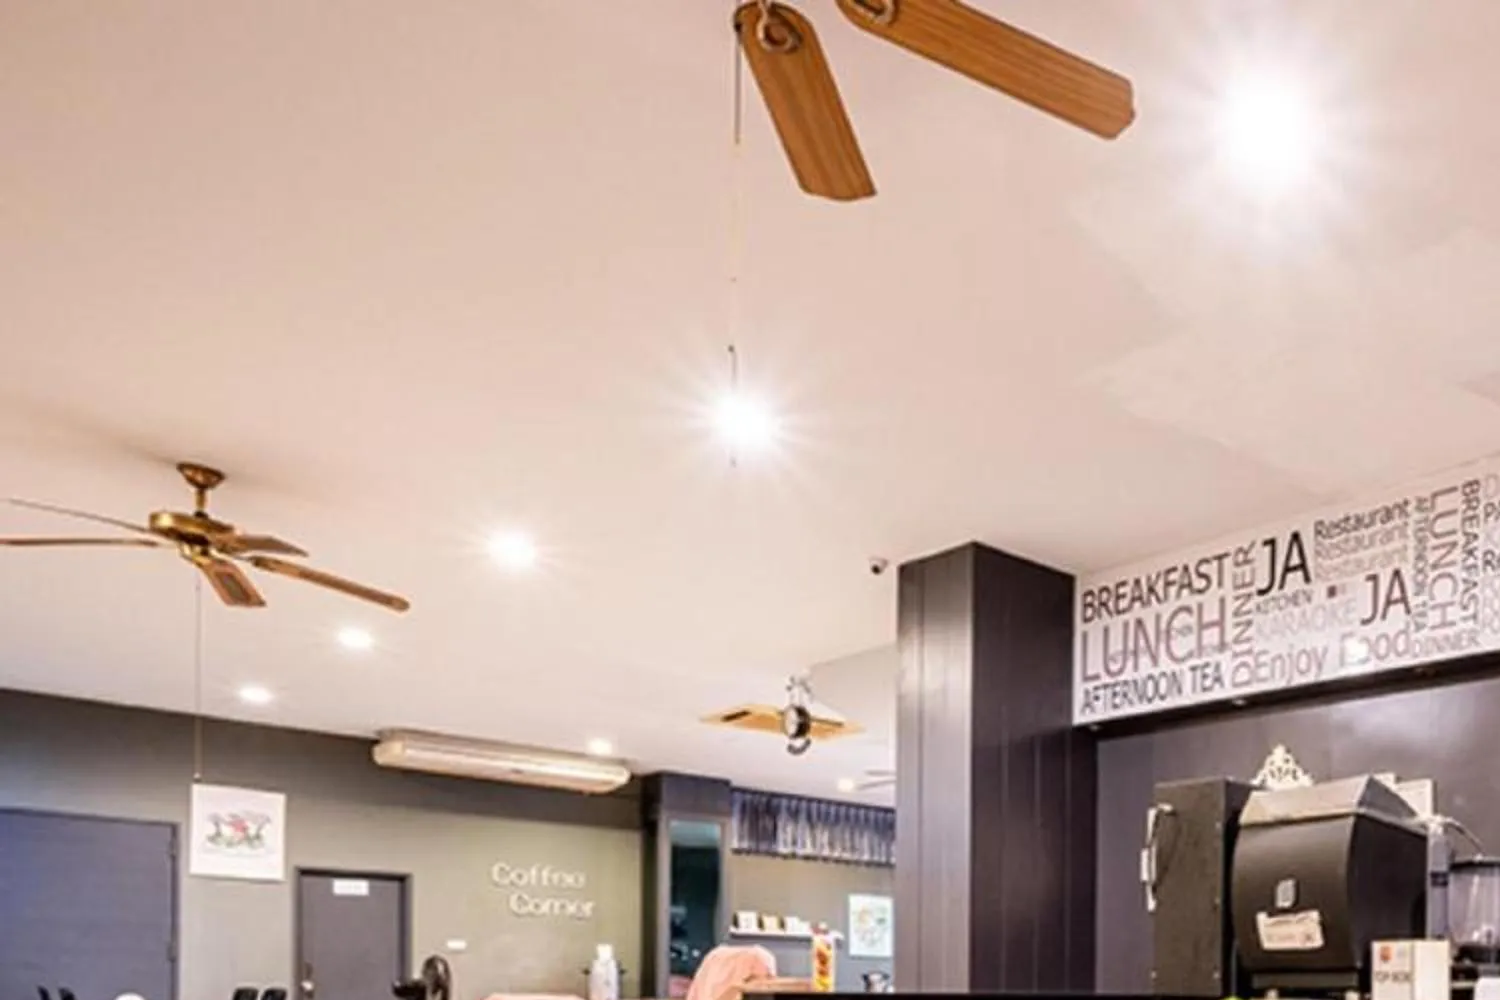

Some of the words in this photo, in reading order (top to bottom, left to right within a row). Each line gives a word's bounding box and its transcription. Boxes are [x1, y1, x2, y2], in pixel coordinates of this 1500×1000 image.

[1314, 498, 1410, 538] Restaurant
[1460, 479, 1481, 624] BREAKFAST
[1082, 553, 1231, 623] BREAKFAST
[1256, 530, 1312, 596] JA
[1428, 485, 1458, 629] LUNCH
[1231, 541, 1256, 688] DINNER
[1360, 567, 1411, 625] JA
[1082, 597, 1227, 682] LUNCH
[1255, 644, 1328, 685] Enjoy
[1080, 670, 1183, 714] AFTERNOON
[1189, 661, 1225, 693] TEA
